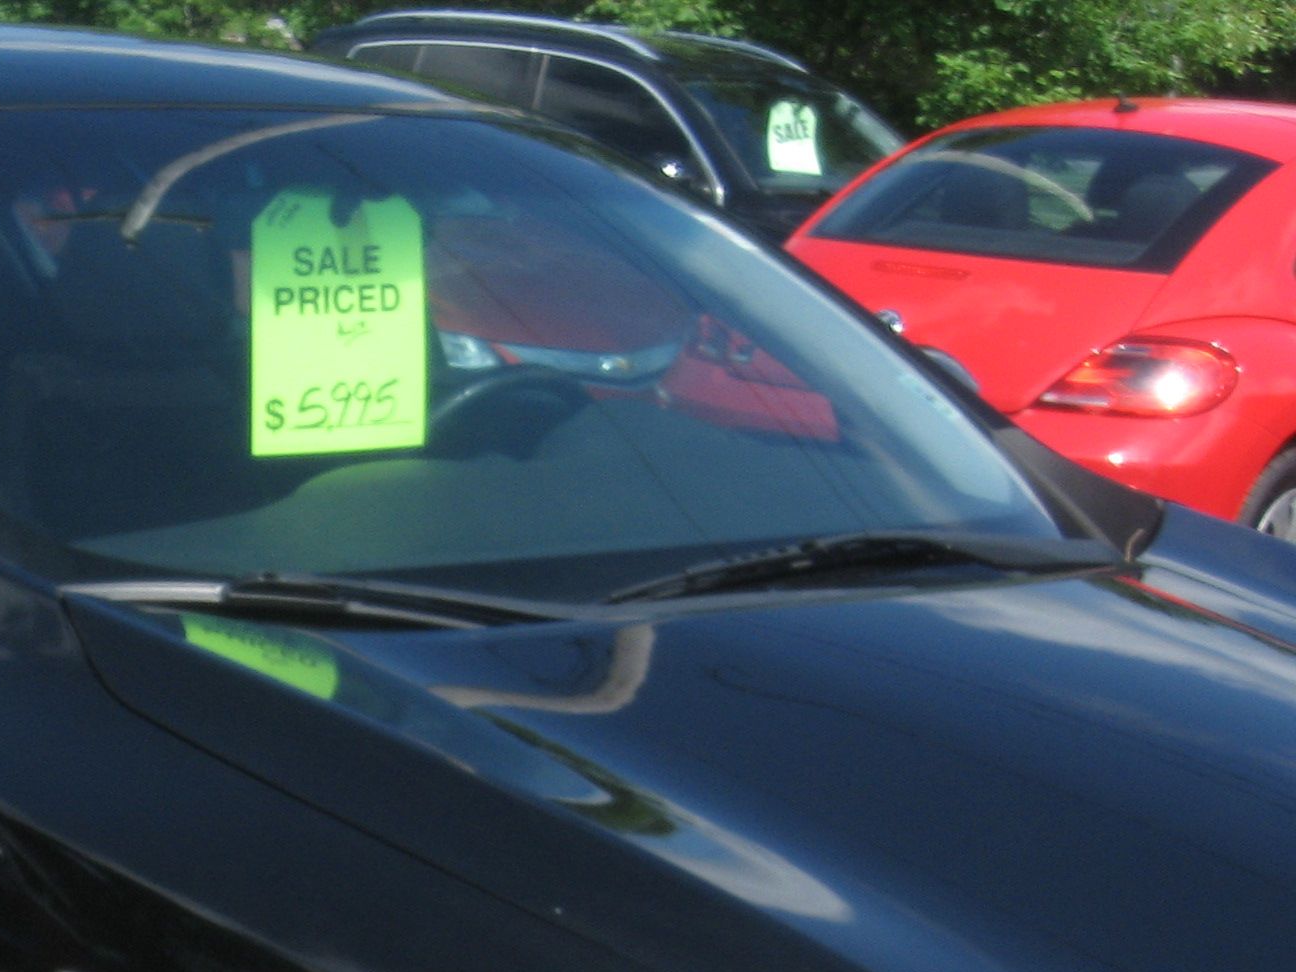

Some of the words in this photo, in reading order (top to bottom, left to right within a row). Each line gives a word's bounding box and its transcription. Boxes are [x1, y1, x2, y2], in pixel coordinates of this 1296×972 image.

[773, 119, 810, 144] SALE
[292, 244, 382, 277] SALE
[273, 283, 401, 316] PRICED
